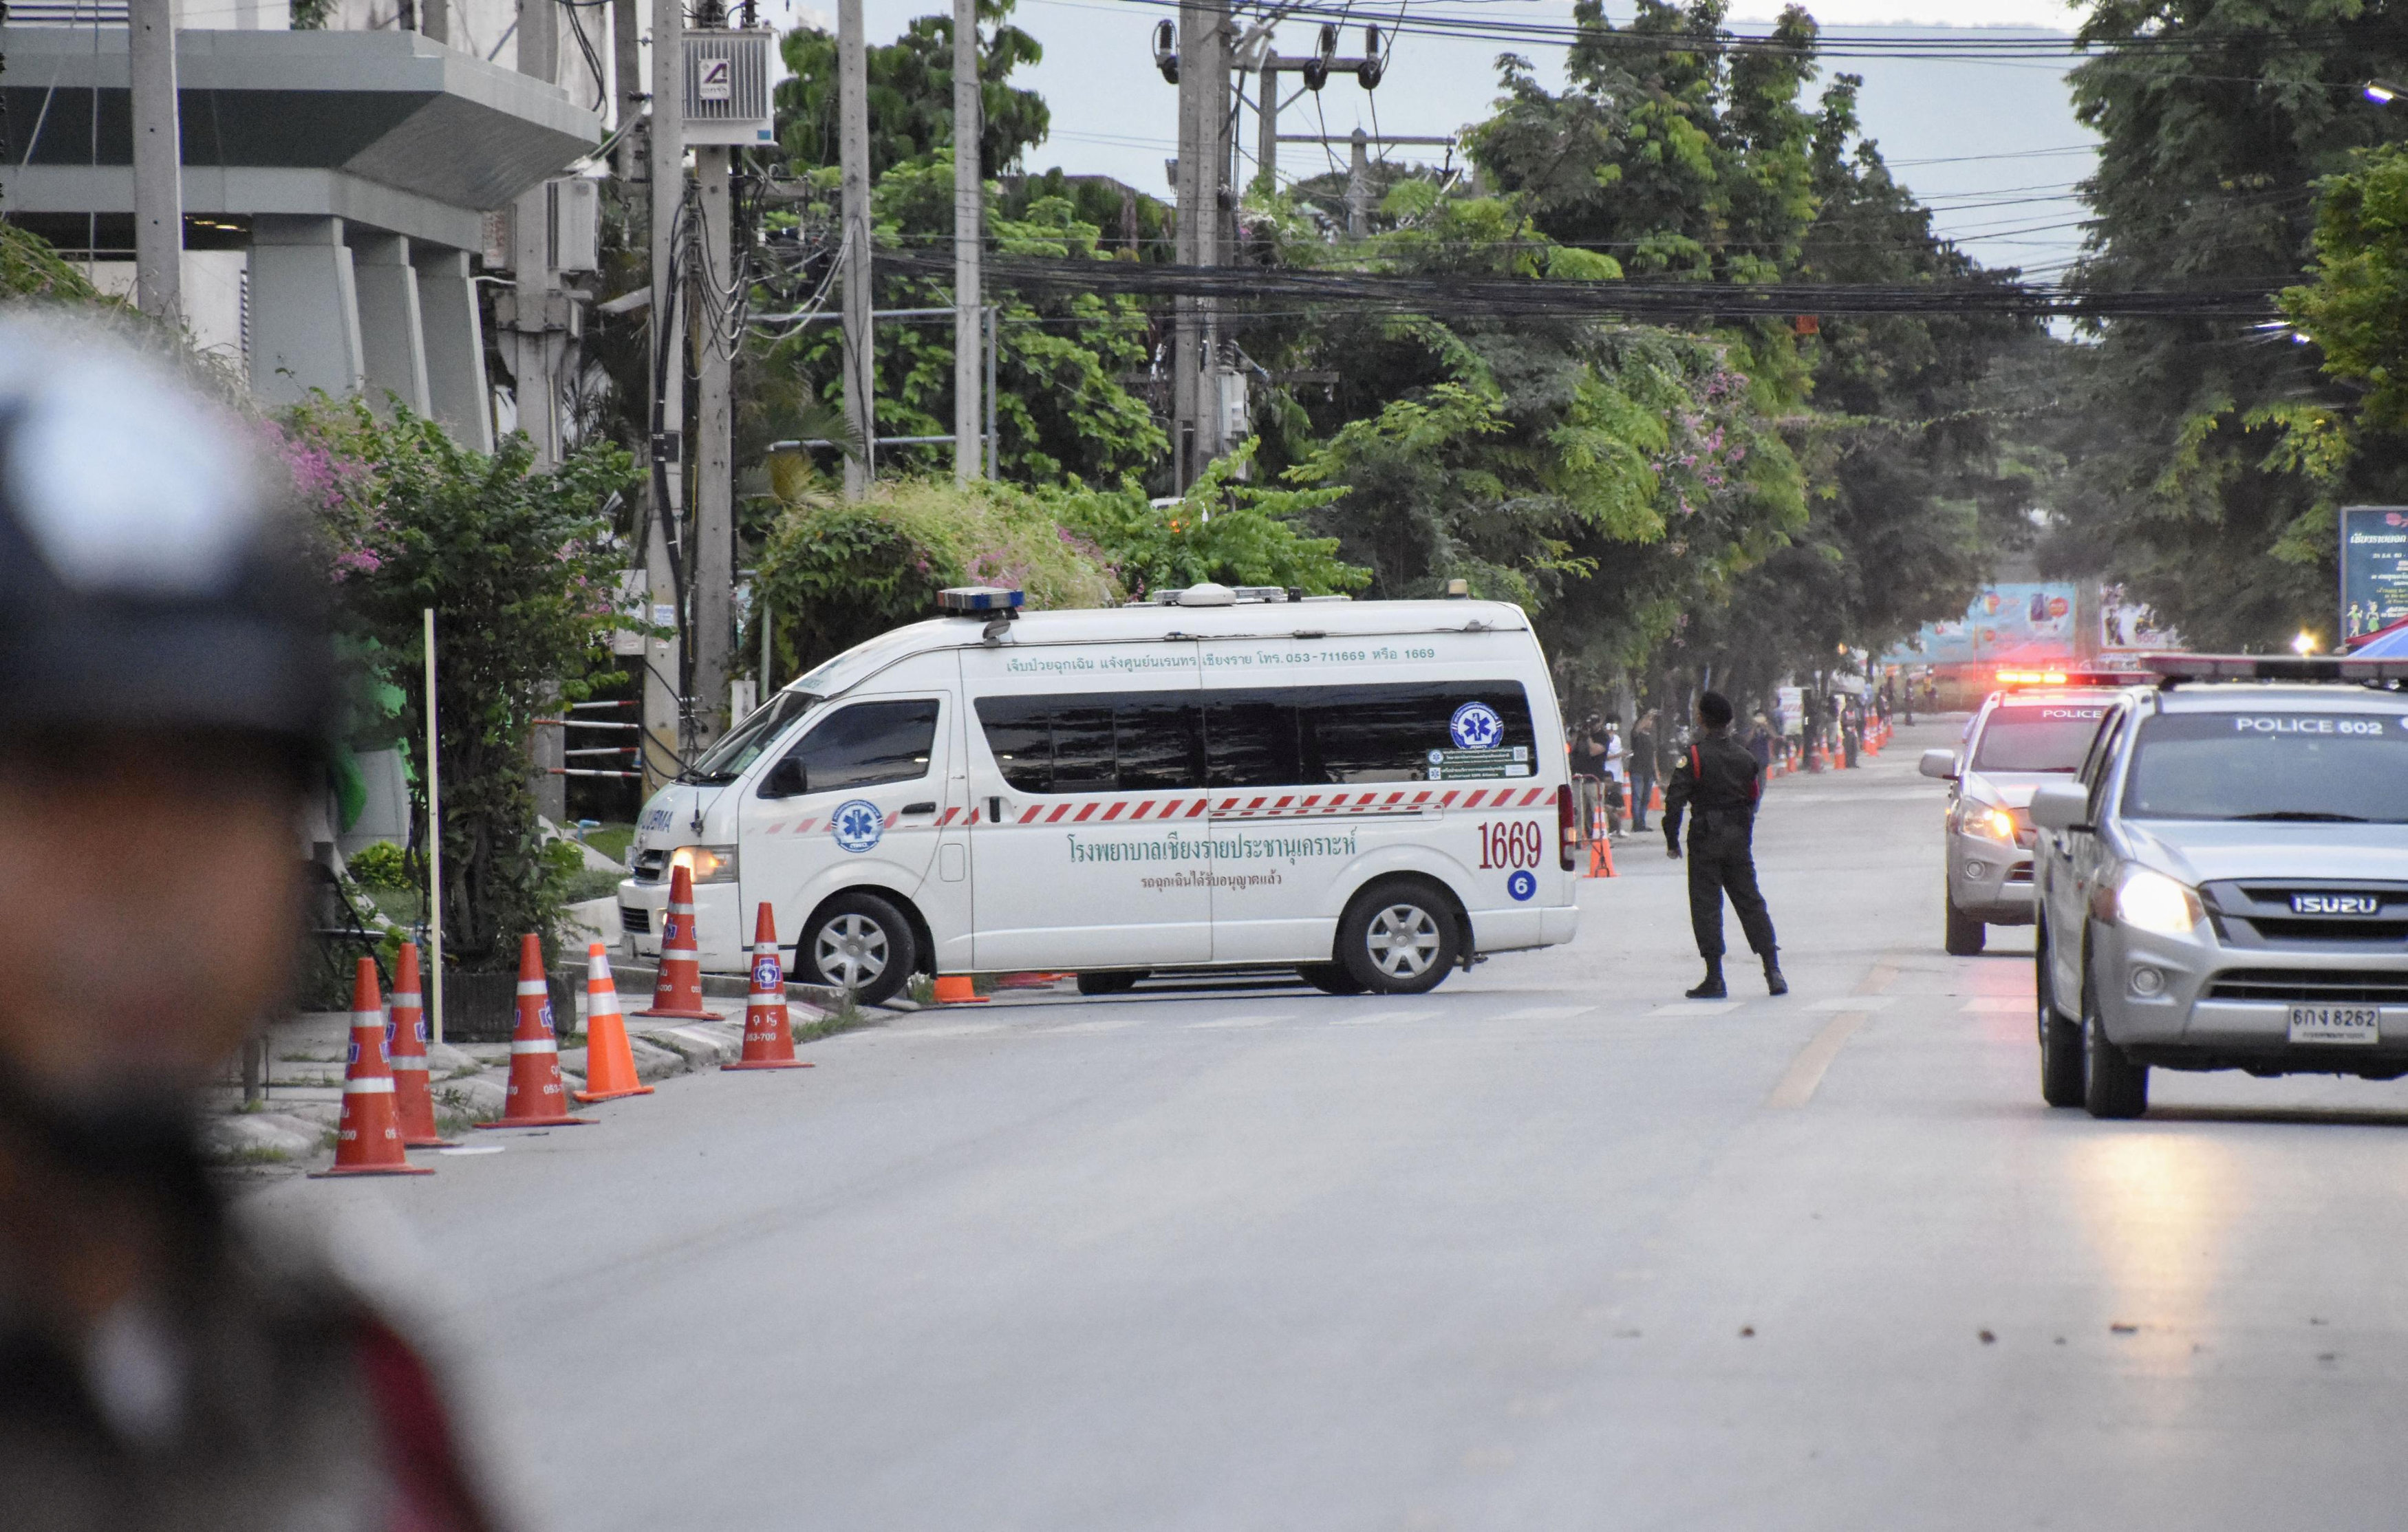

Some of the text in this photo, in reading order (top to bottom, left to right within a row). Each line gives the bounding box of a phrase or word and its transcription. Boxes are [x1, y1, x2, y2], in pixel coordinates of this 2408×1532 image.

[1405, 649, 1435, 659] 1669
[2043, 709, 2103, 718] POLICE
[2237, 718, 2383, 735] POLICE 602
[1066, 826, 1357, 865] โรงพยาบาลเชียงรายประชานุเคราะห์
[1477, 820, 1542, 870] 1669
[1514, 877, 1528, 894] 6
[2294, 896, 2377, 914] ISUZU
[2333, 1009, 2376, 1027] 8262
